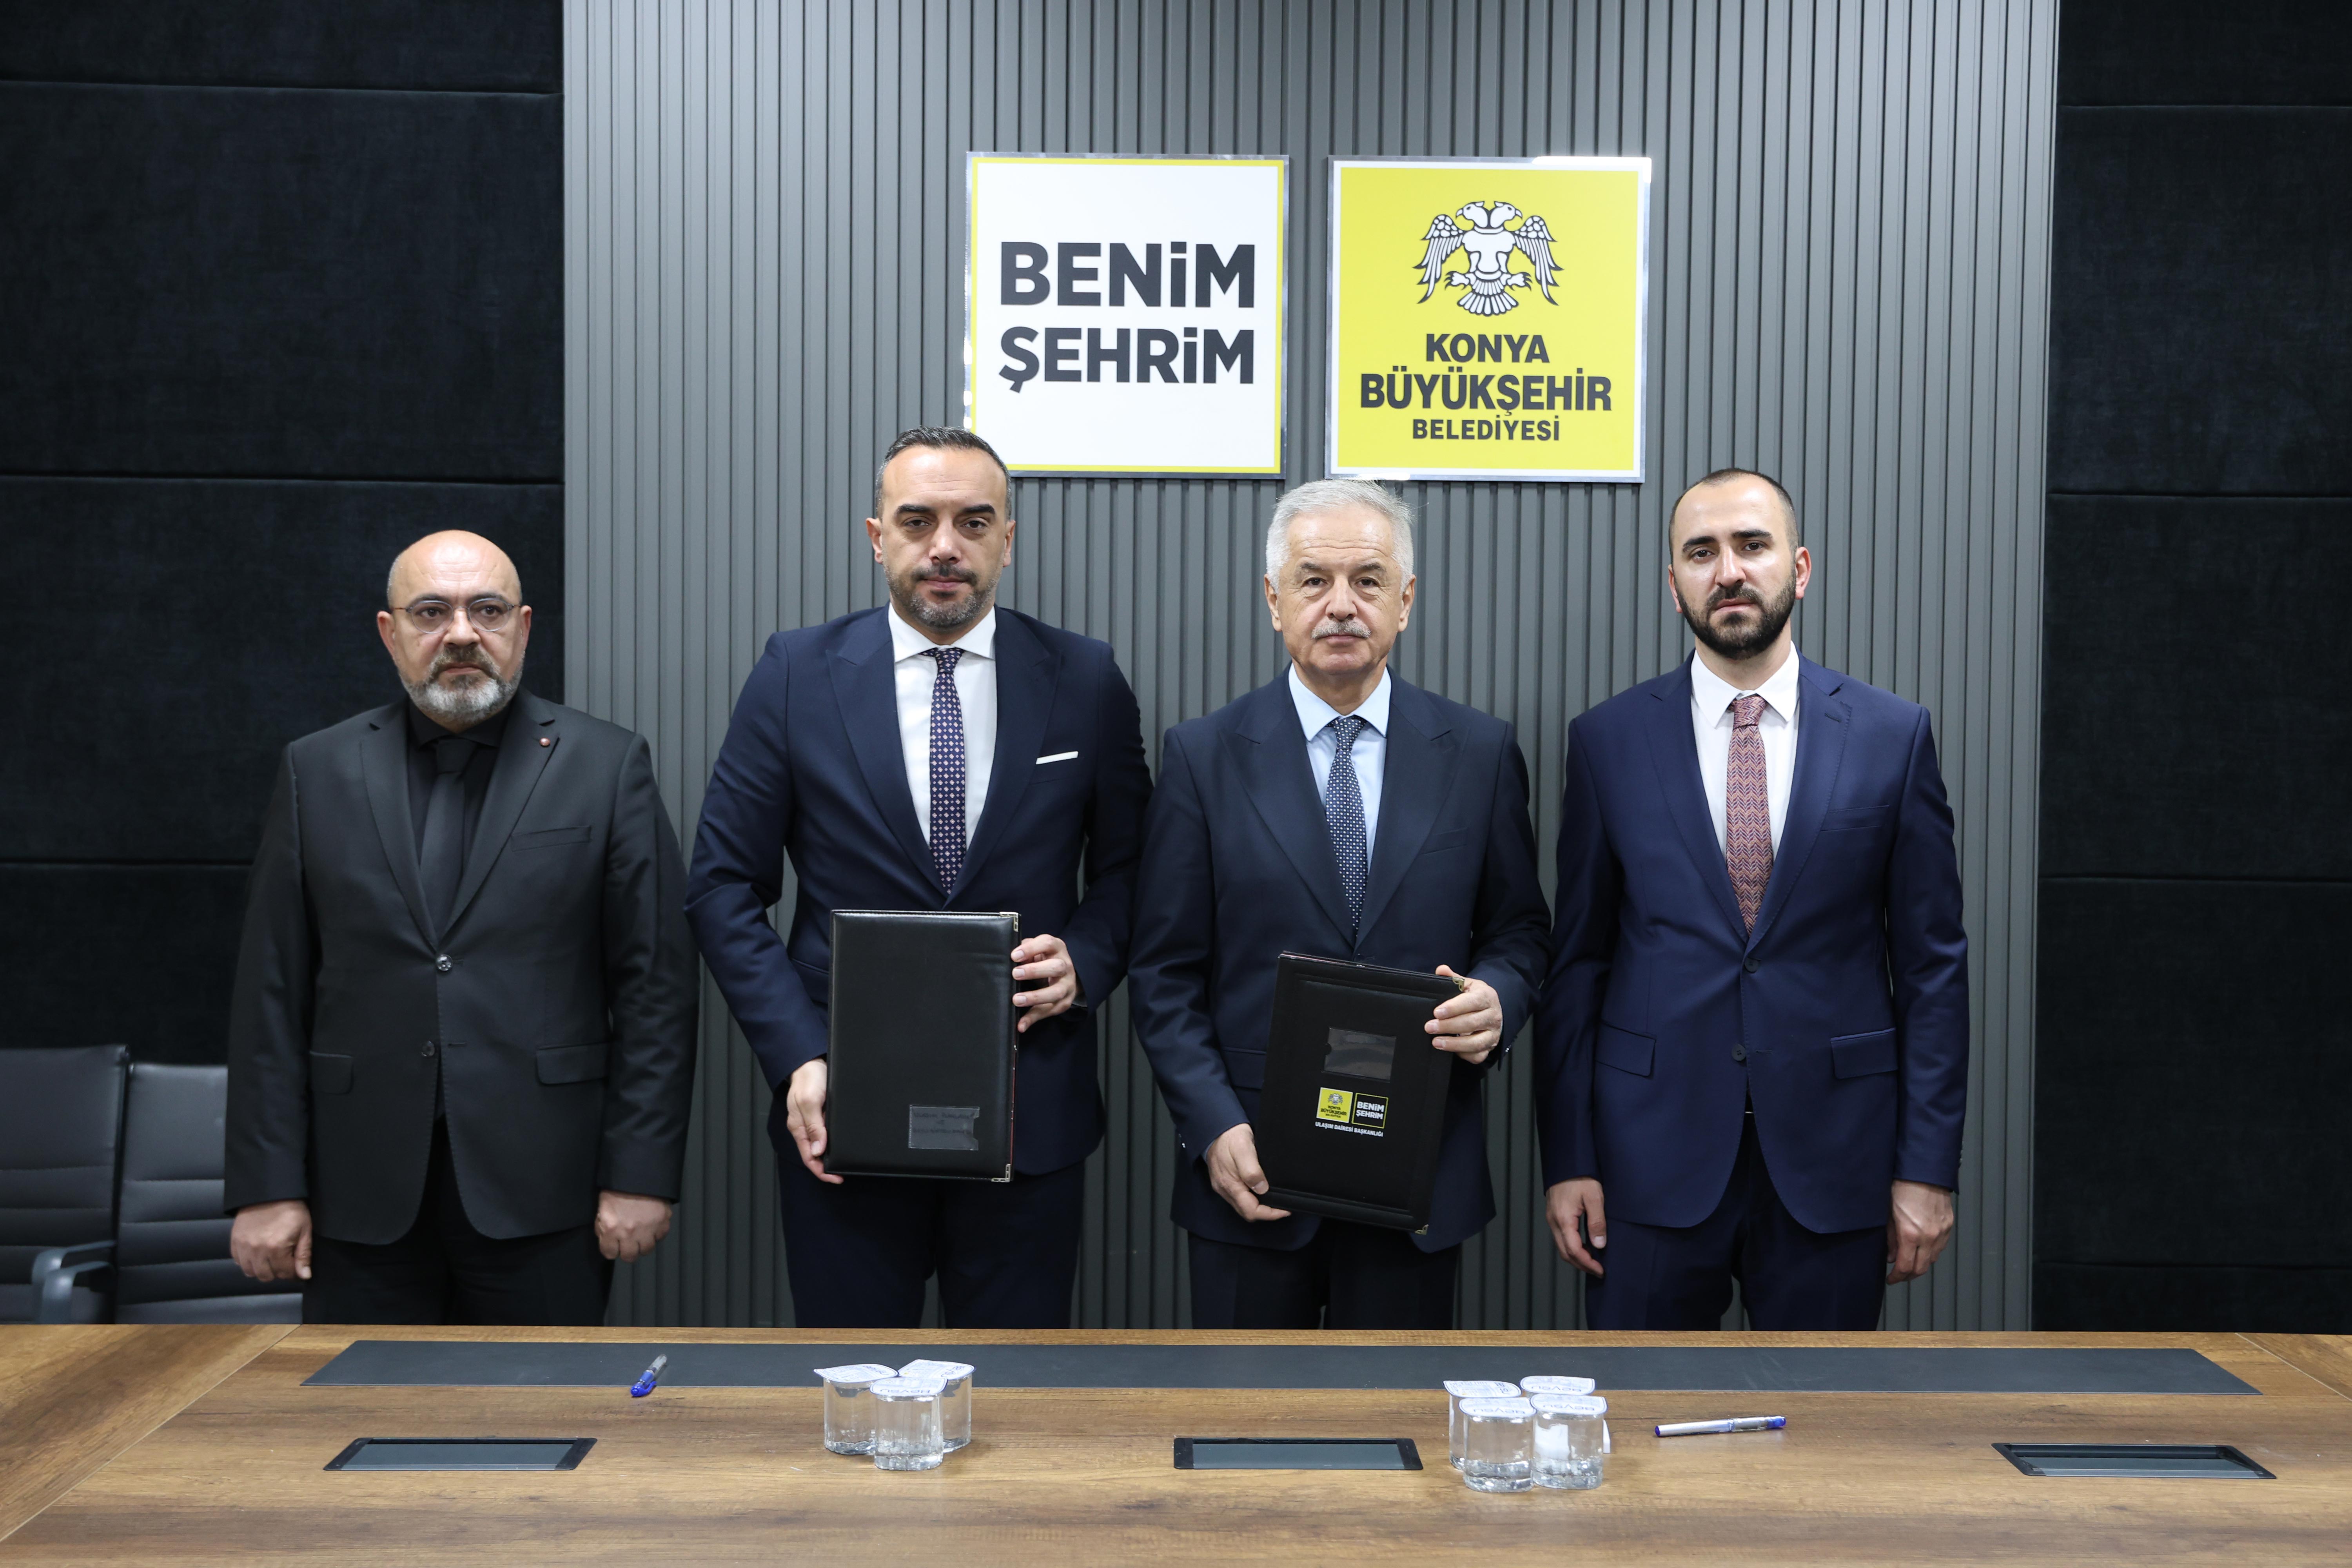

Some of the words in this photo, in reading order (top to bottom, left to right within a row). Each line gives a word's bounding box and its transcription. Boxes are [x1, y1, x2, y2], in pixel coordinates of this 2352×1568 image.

[1426, 333, 1550, 363] KONYA
[1361, 365, 1611, 416] BÜYÜKŞEHİR
[1413, 416, 1559, 441] BELEDİYESİ
[1315, 1121, 1334, 1129] ULAŞIM
[1334, 1124, 1354, 1132] DAİRESİ
[1354, 1127, 1384, 1137] BAŞKANLIĞI
